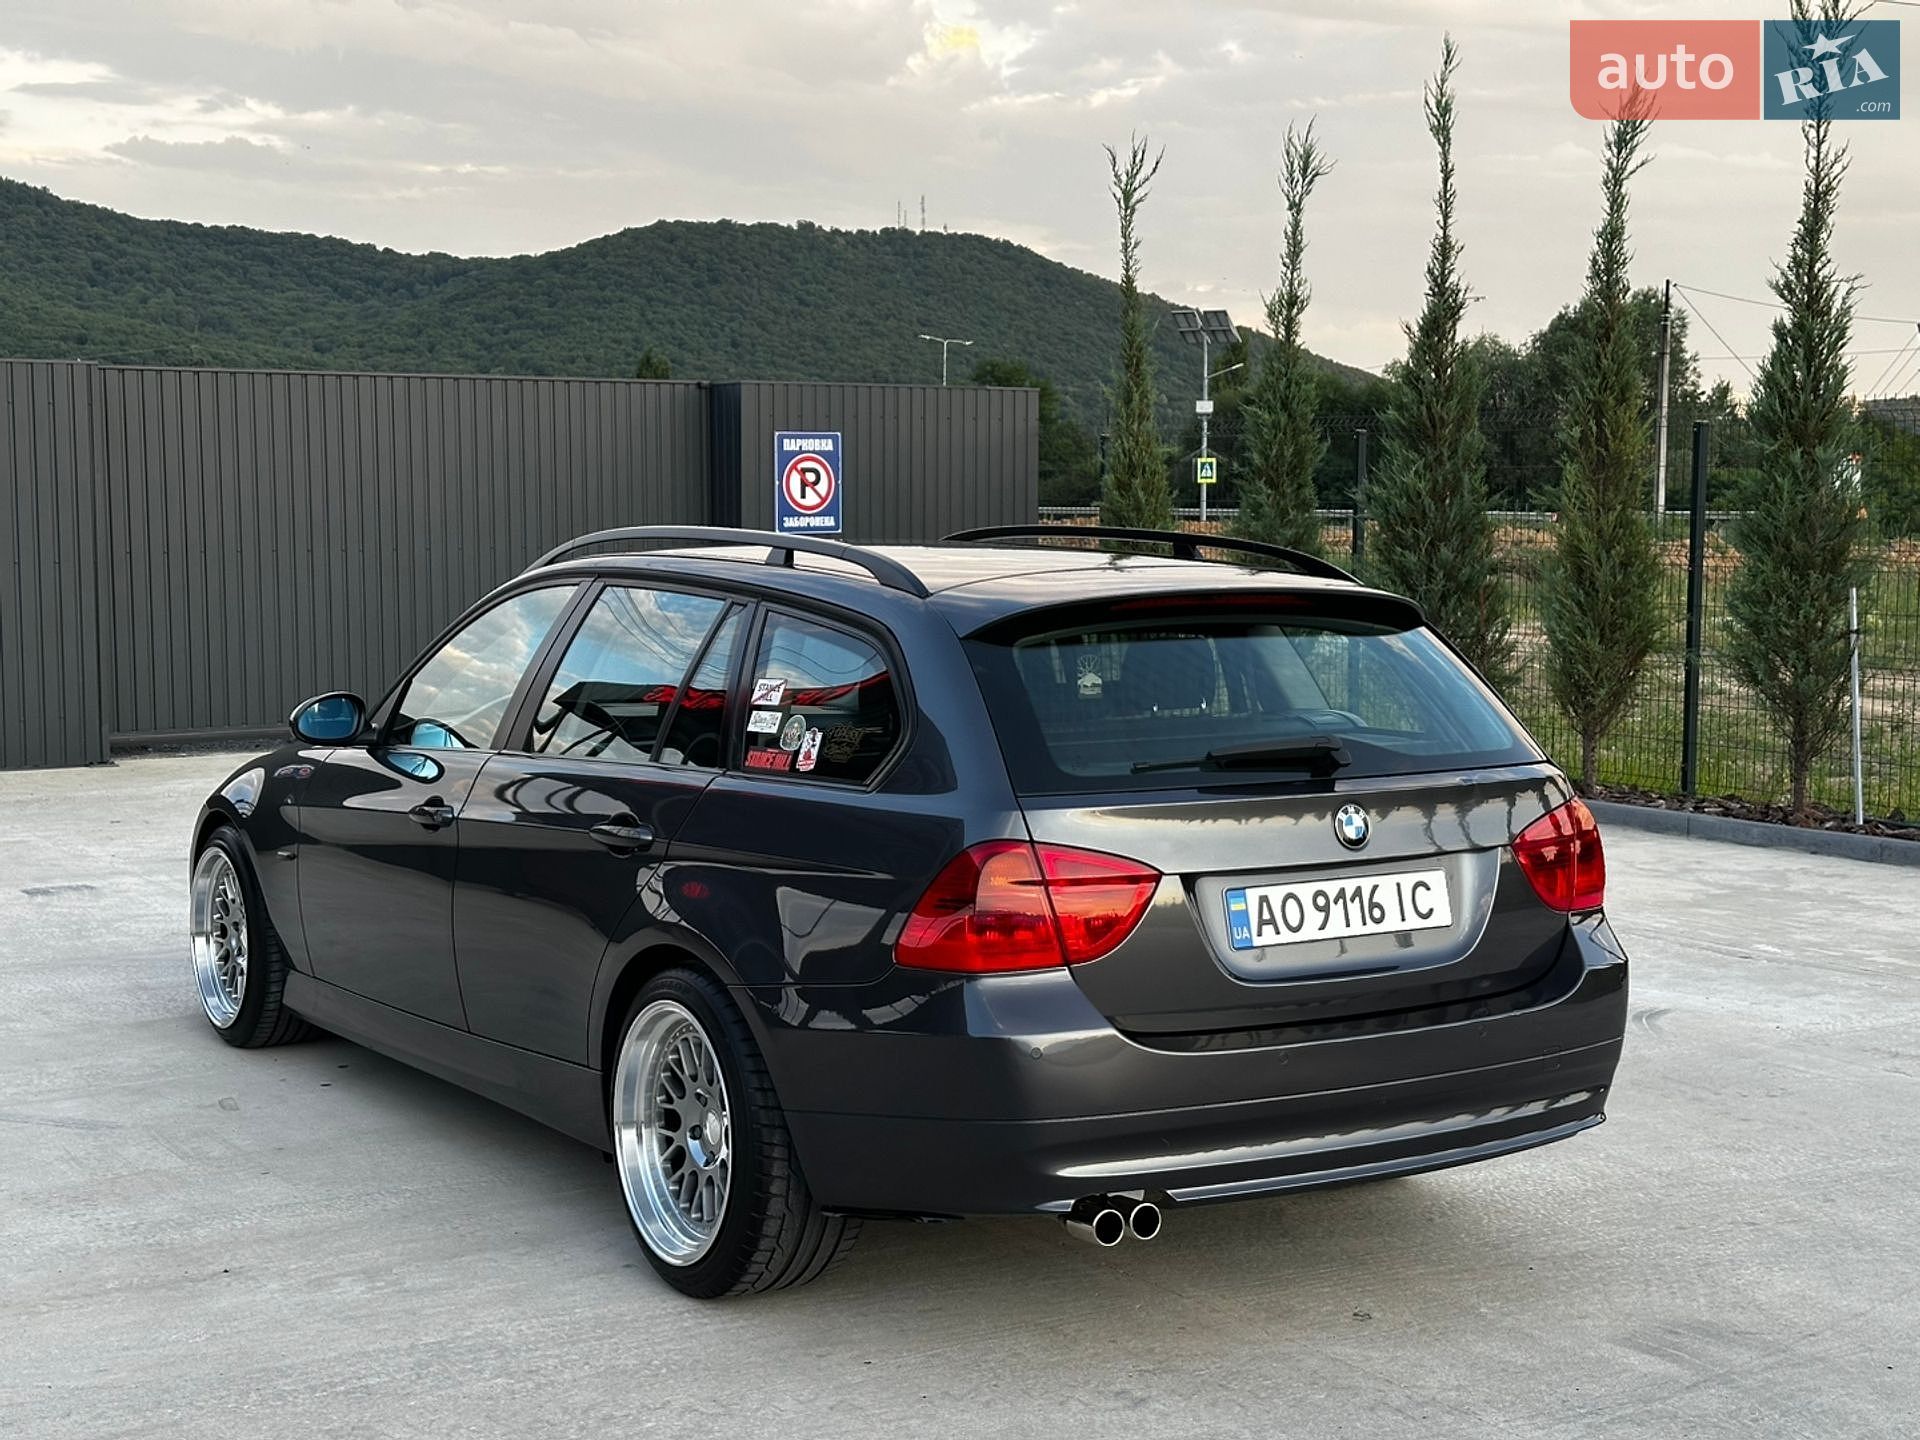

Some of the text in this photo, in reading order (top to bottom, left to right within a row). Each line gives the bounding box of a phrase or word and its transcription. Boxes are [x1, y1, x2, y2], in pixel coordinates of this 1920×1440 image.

[782, 438, 834, 451] ПАРКОВКА
[782, 515, 836, 528] ЗАБОРОНЕНА
[1337, 804, 1369, 820] BMW
[1256, 880, 1435, 938] AO 9116 IC
[1234, 926, 1250, 940] UA
